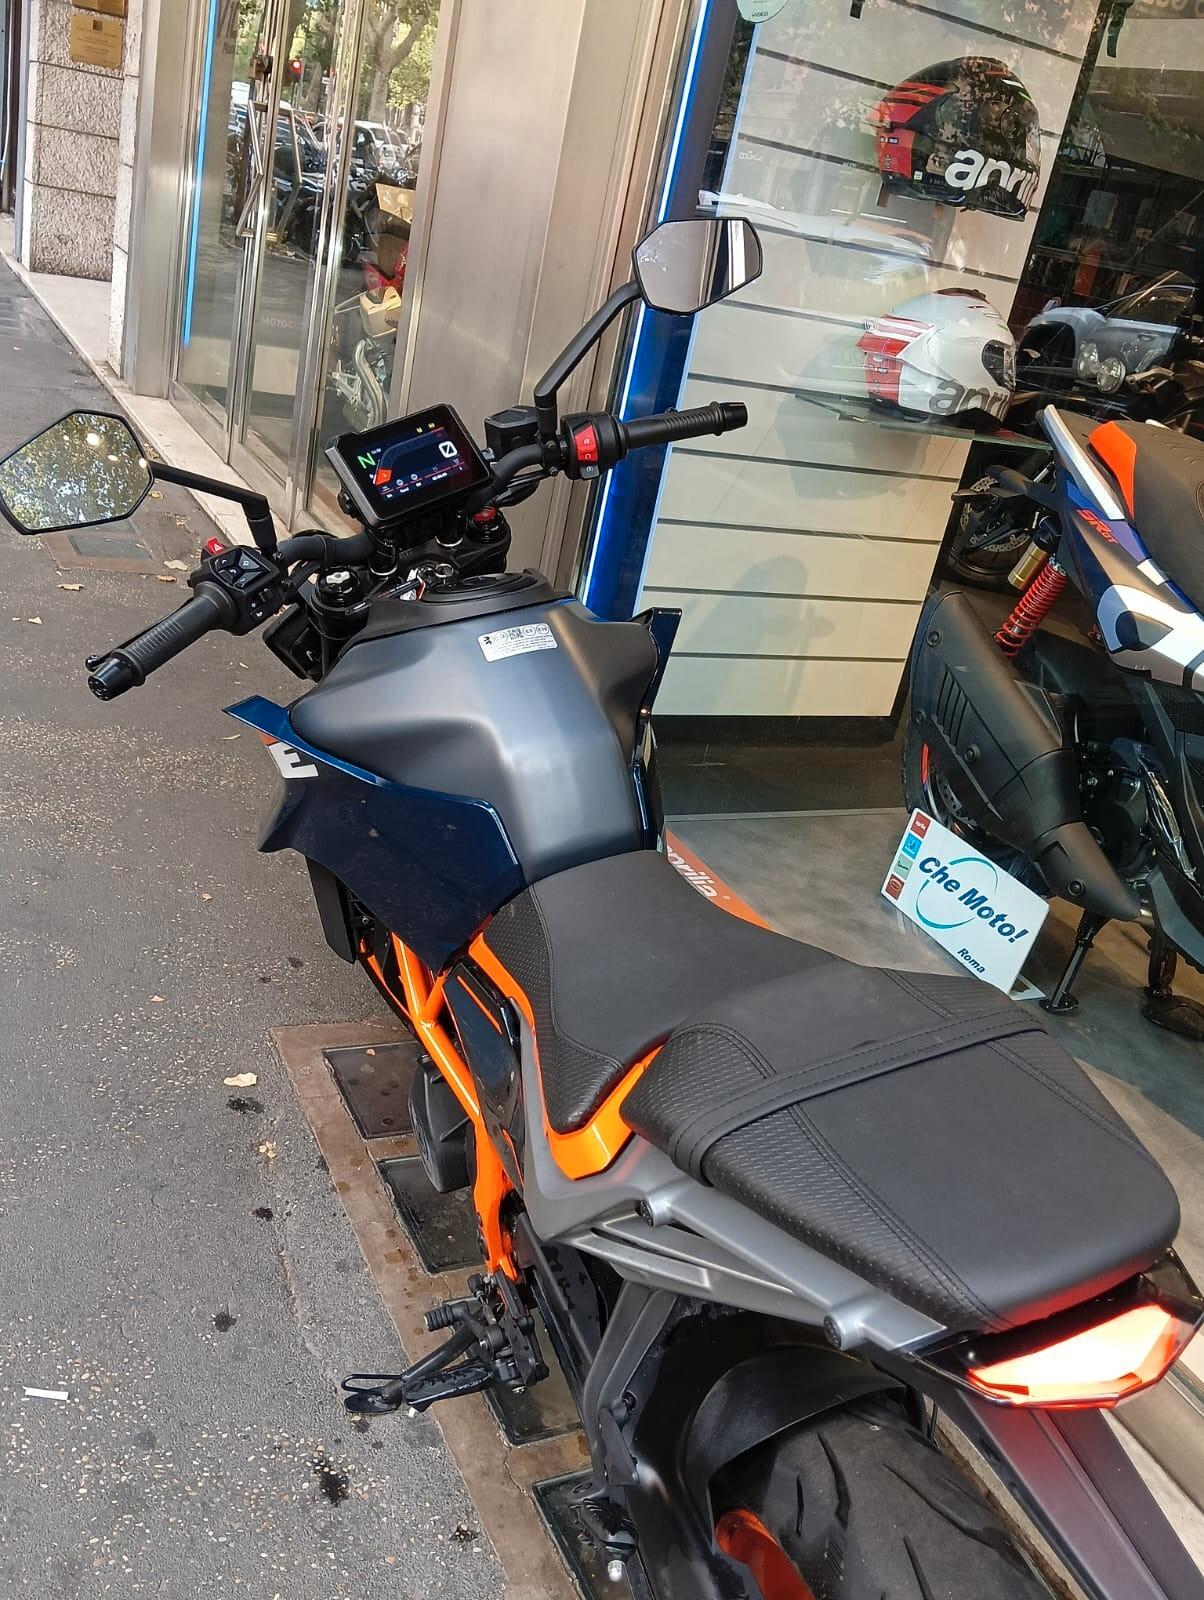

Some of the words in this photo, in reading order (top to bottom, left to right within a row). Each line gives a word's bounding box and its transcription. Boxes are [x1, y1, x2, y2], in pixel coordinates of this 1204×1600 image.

[357, 452, 376, 469] N
[918, 856, 961, 893] Che
[957, 886, 1030, 944] Moto!
[957, 947, 987, 974] Roma
